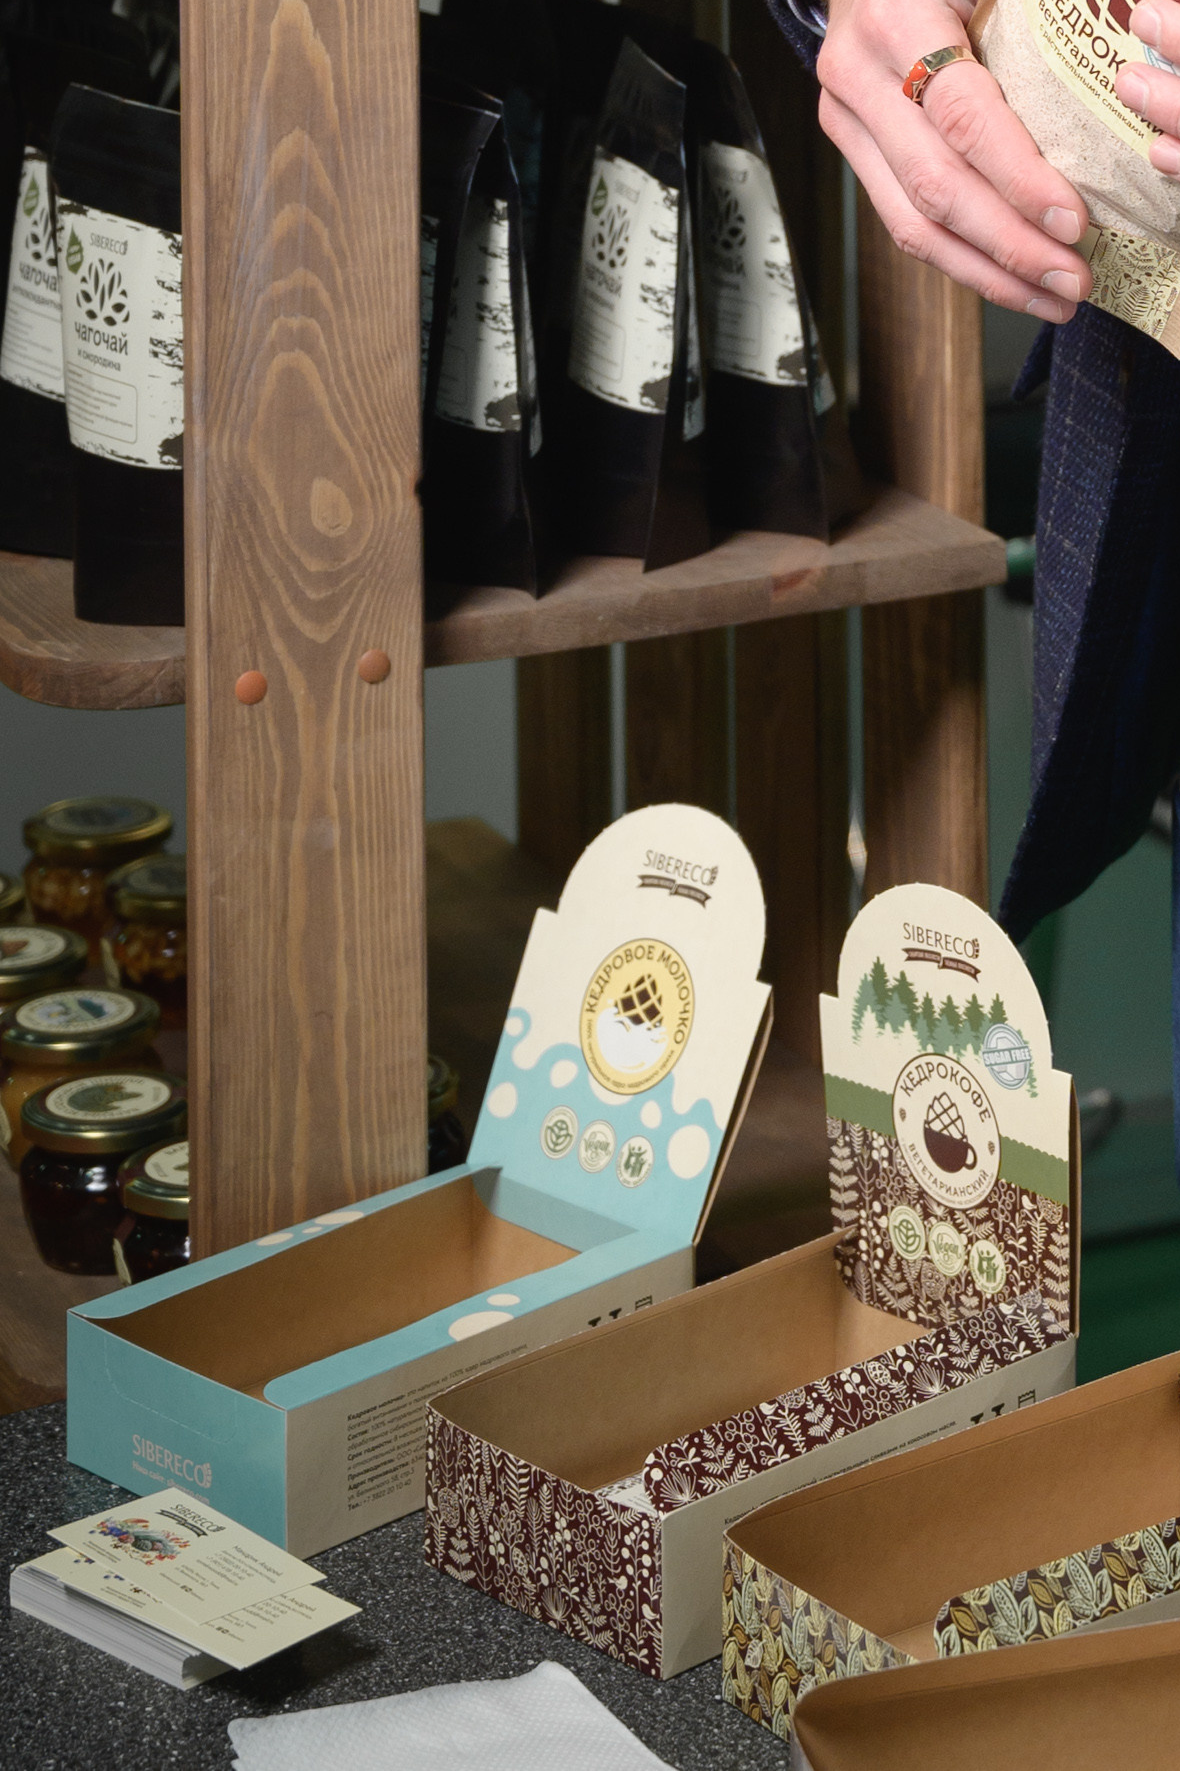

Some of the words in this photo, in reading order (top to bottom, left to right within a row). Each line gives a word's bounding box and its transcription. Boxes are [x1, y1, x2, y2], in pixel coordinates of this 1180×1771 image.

[1042, 30, 1101, 100] растительными
[1101, 98, 1145, 140] сливками
[89, 232, 128, 256] SIBERECO
[19, 260, 58, 293] чагоча
[74, 321, 129, 356] чагочай
[643, 850, 713, 886] SIBERECO
[903, 922, 975, 959] SIBERECO
[584, 945, 656, 1014] КЕДРОВОЕ
[657, 951, 692, 1046] МОЛОЧКО
[983, 1050, 1010, 1067] SUGAR
[1010, 1045, 1032, 1062] FREE
[900, 1061, 992, 1124] КЕДРОКОФЕ
[908, 1142, 990, 1199] ВЕГЕТАРИАНСКИЙ
[932, 1232, 962, 1262] Vegan
[132, 1434, 207, 1488] SIBERECO
[170, 1503, 220, 1533] SIBERECO
